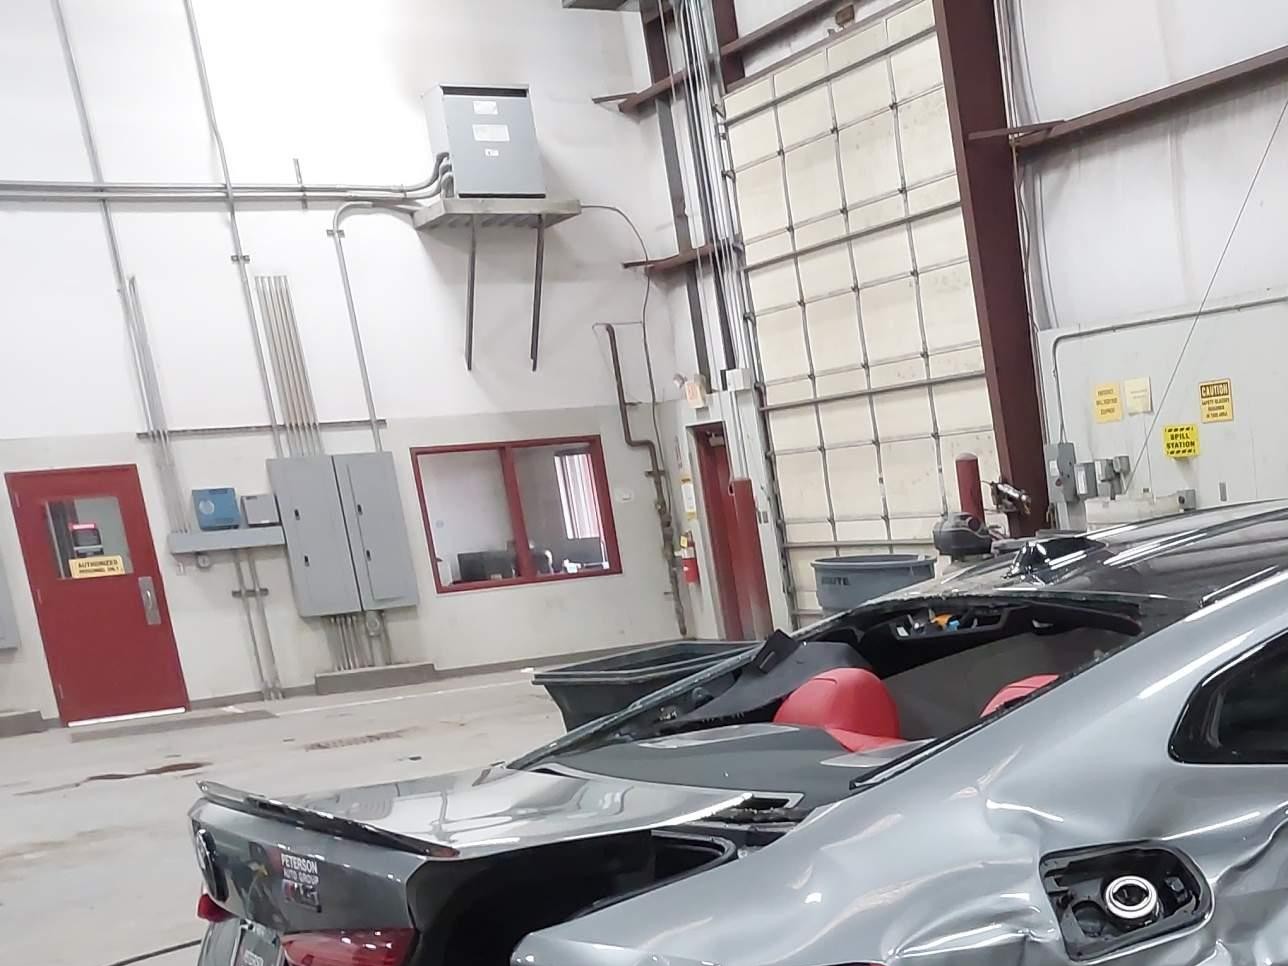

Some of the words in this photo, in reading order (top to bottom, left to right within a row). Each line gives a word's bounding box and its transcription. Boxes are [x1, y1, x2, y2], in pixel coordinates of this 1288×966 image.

[1201, 383, 1228, 397] CAUTION
[1170, 432, 1191, 441] SPILL
[1166, 441, 1195, 449] STATION
[78, 559, 118, 568] AUTHORIZED
[281, 853, 319, 875] PETERSON
